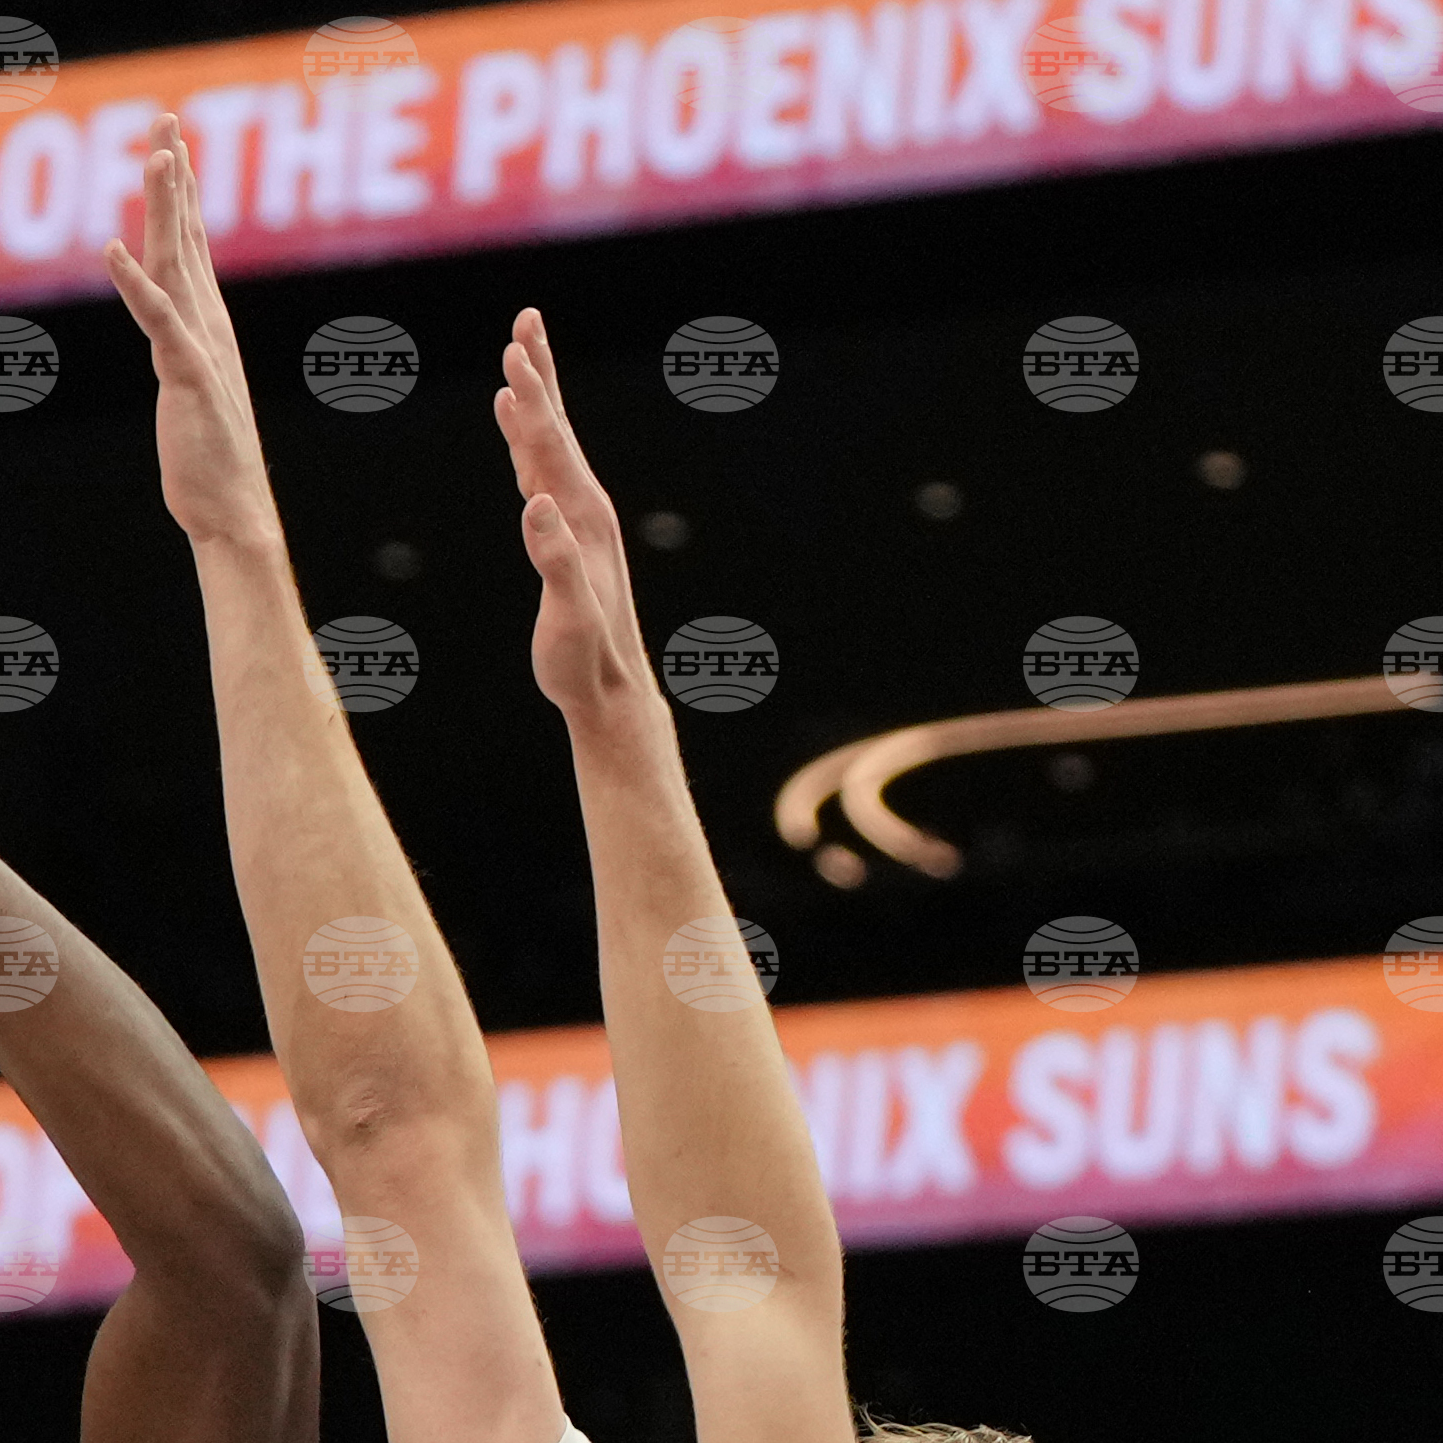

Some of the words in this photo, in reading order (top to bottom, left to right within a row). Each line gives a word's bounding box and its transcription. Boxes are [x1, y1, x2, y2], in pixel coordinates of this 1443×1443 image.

[180, 64, 439, 240] THE
[454, 0, 1042, 200] PHOENIX
[1068, 0, 1443, 124] SUNS
[1001, 1007, 1384, 1190] SUNS
